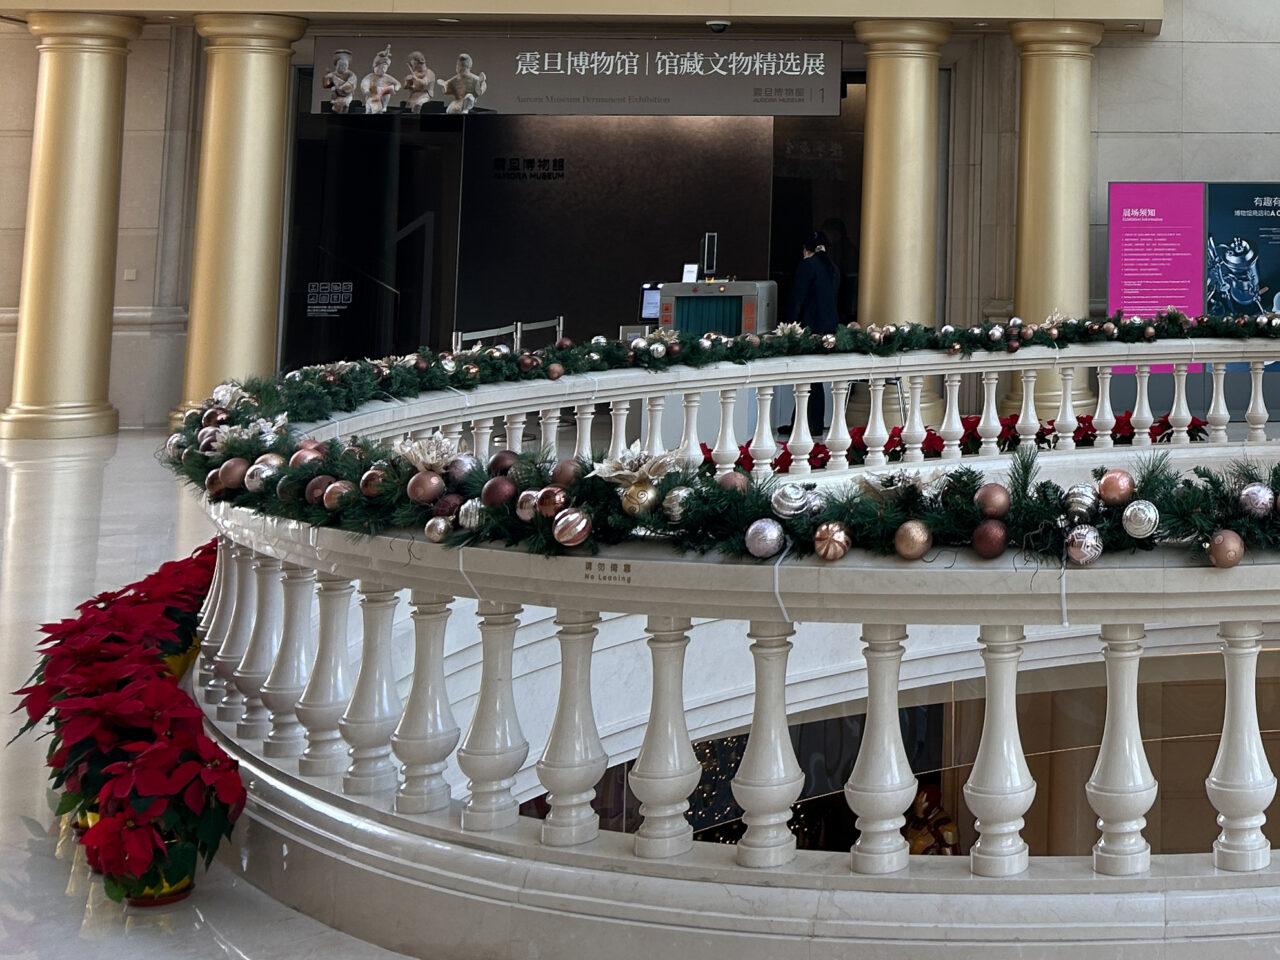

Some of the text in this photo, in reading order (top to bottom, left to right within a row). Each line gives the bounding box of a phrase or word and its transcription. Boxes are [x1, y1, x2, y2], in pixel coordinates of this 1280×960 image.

[515, 51, 826, 76] 震旦博物馆 馆藏文物精选展
